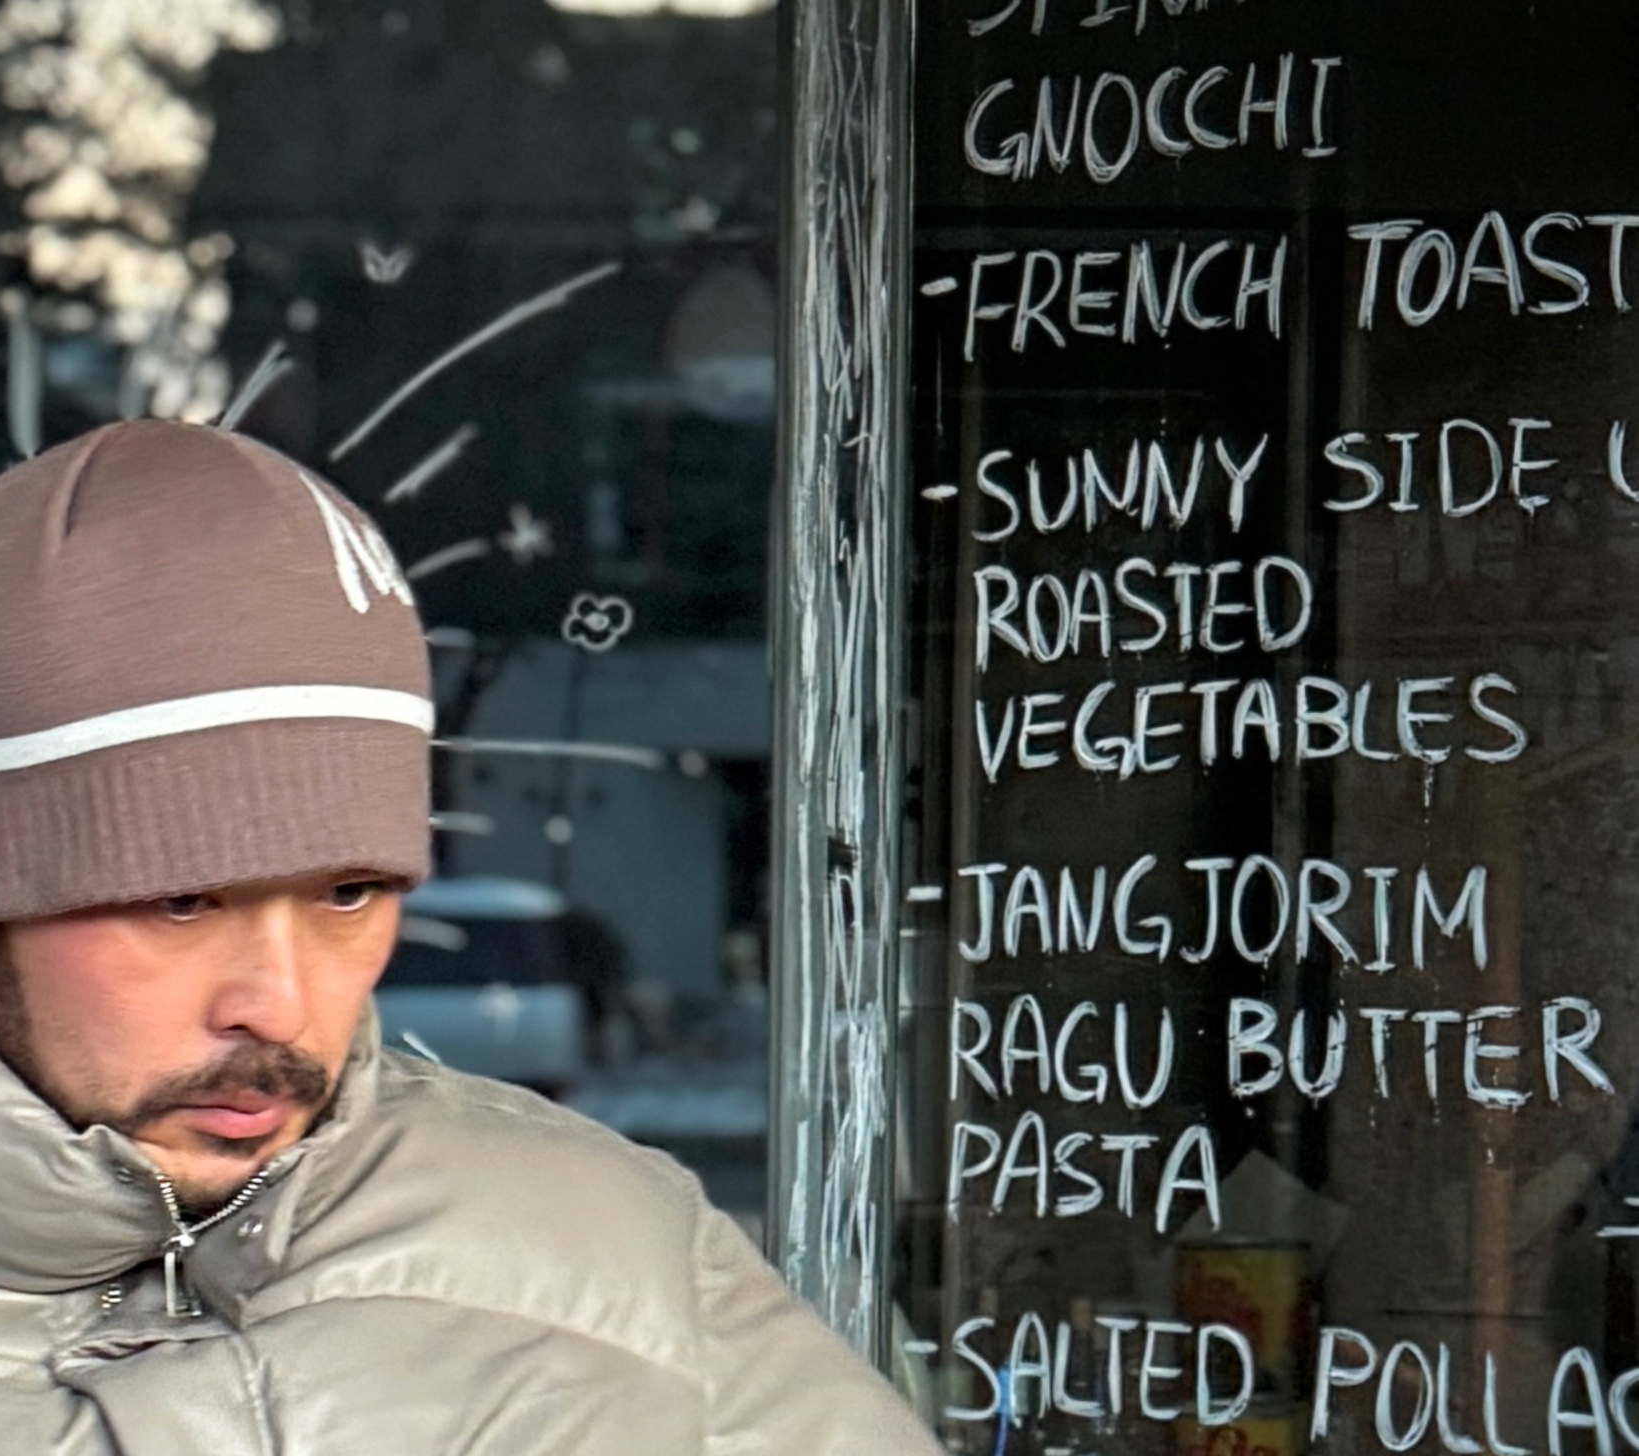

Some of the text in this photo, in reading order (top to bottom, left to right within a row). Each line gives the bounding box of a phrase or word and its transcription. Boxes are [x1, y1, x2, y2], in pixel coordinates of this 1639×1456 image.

[964, 51, 1341, 183] GNOCCHI
[1346, 211, 1639, 330] TOAST
[1322, 418, 1561, 517] SIDE
[973, 556, 1313, 672] ROASTED
[976, 673, 1528, 783] VEGETABLES
[951, 993, 1614, 1109] RAGU BUTTER
[948, 1110, 1219, 1233] PASTA
